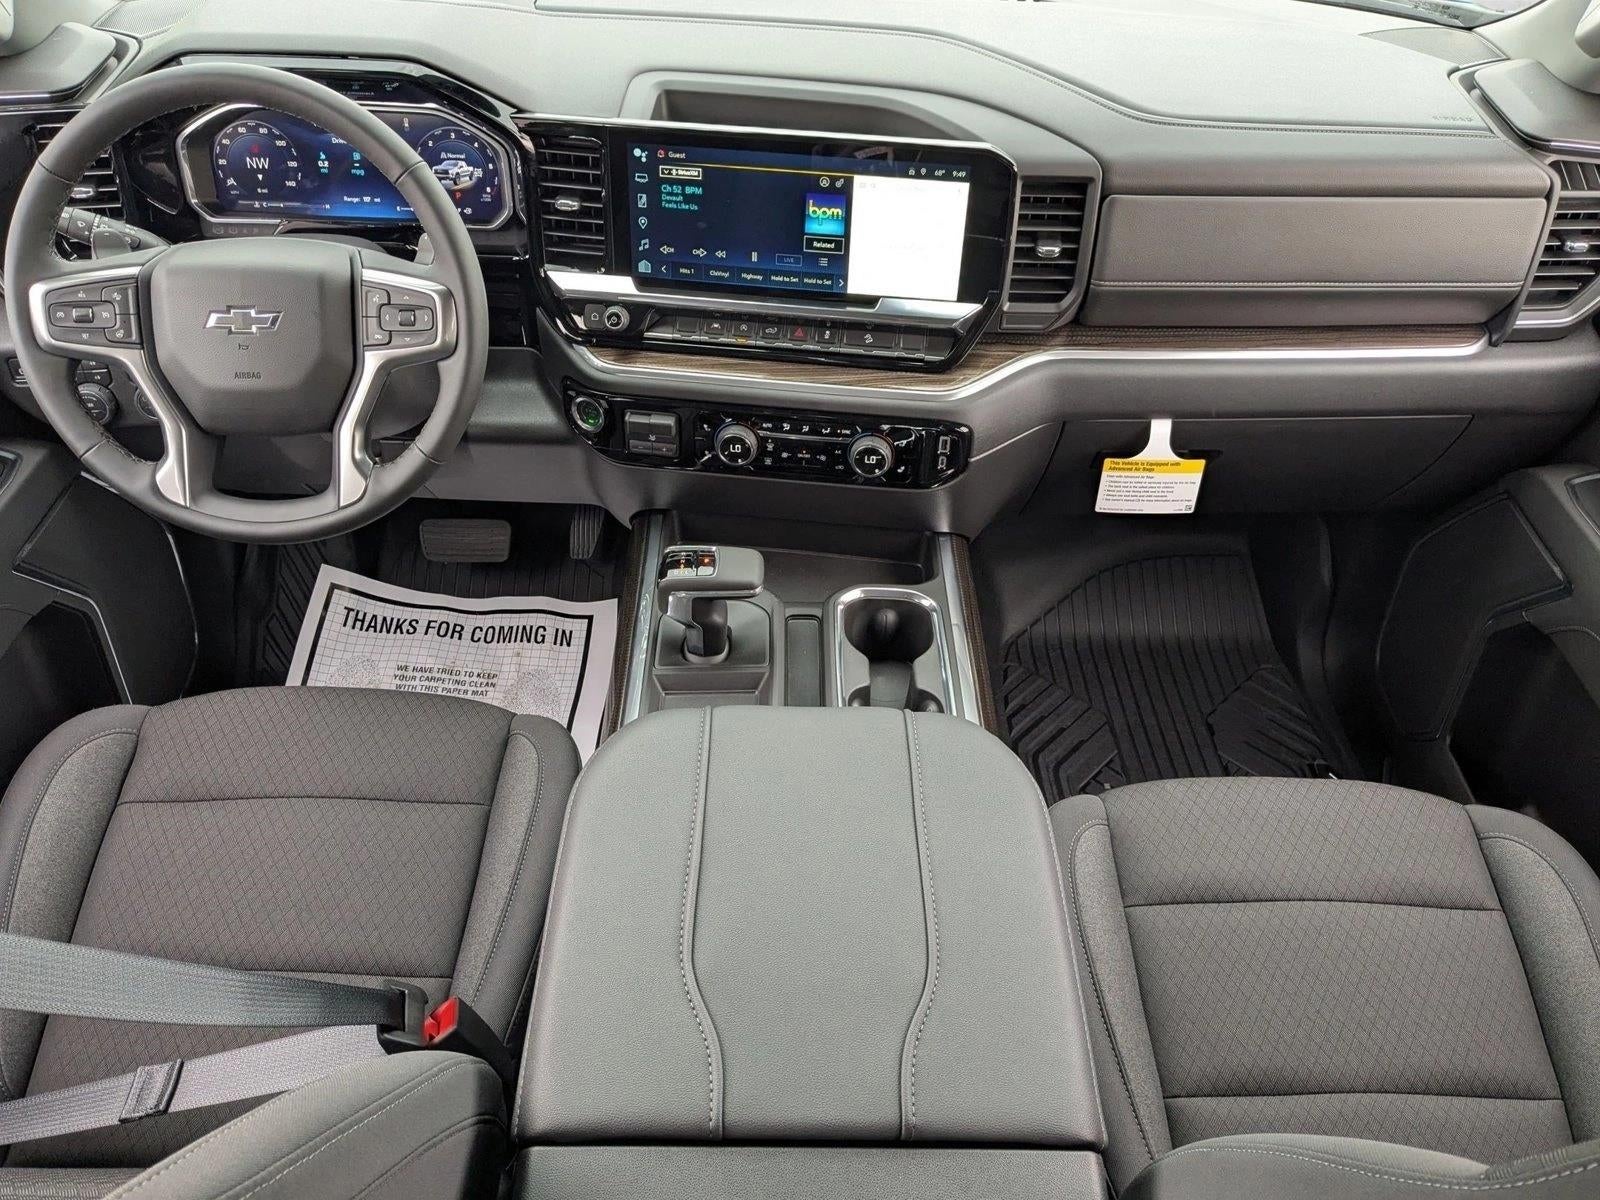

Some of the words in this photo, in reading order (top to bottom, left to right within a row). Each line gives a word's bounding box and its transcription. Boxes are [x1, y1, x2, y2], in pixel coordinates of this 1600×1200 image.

[246, 156, 269, 170] NW
[952, 170, 966, 178] 9:49
[661, 184, 672, 192] Ch
[685, 186, 702, 194] BPM
[809, 200, 842, 225] bpm
[813, 241, 836, 249] Related
[741, 272, 763, 280] Highway
[234, 372, 262, 380] AIRBAG
[730, 444, 742, 453] LO
[864, 456, 876, 464] LO
[342, 606, 420, 635] THANKS
[424, 620, 464, 640] FOR
[470, 625, 547, 644] COMING
[553, 628, 573, 648] IN
[396, 664, 410, 672] WE
[412, 665, 434, 674] HAVE
[436, 668, 461, 676] TRIED
[476, 672, 498, 680] KEEP
[394, 674, 417, 682] YOUR
[420, 675, 467, 687] CARPETING
[468, 680, 496, 688] CLEAN
[419, 684, 440, 693] THIS
[441, 687, 469, 696] PAPER
